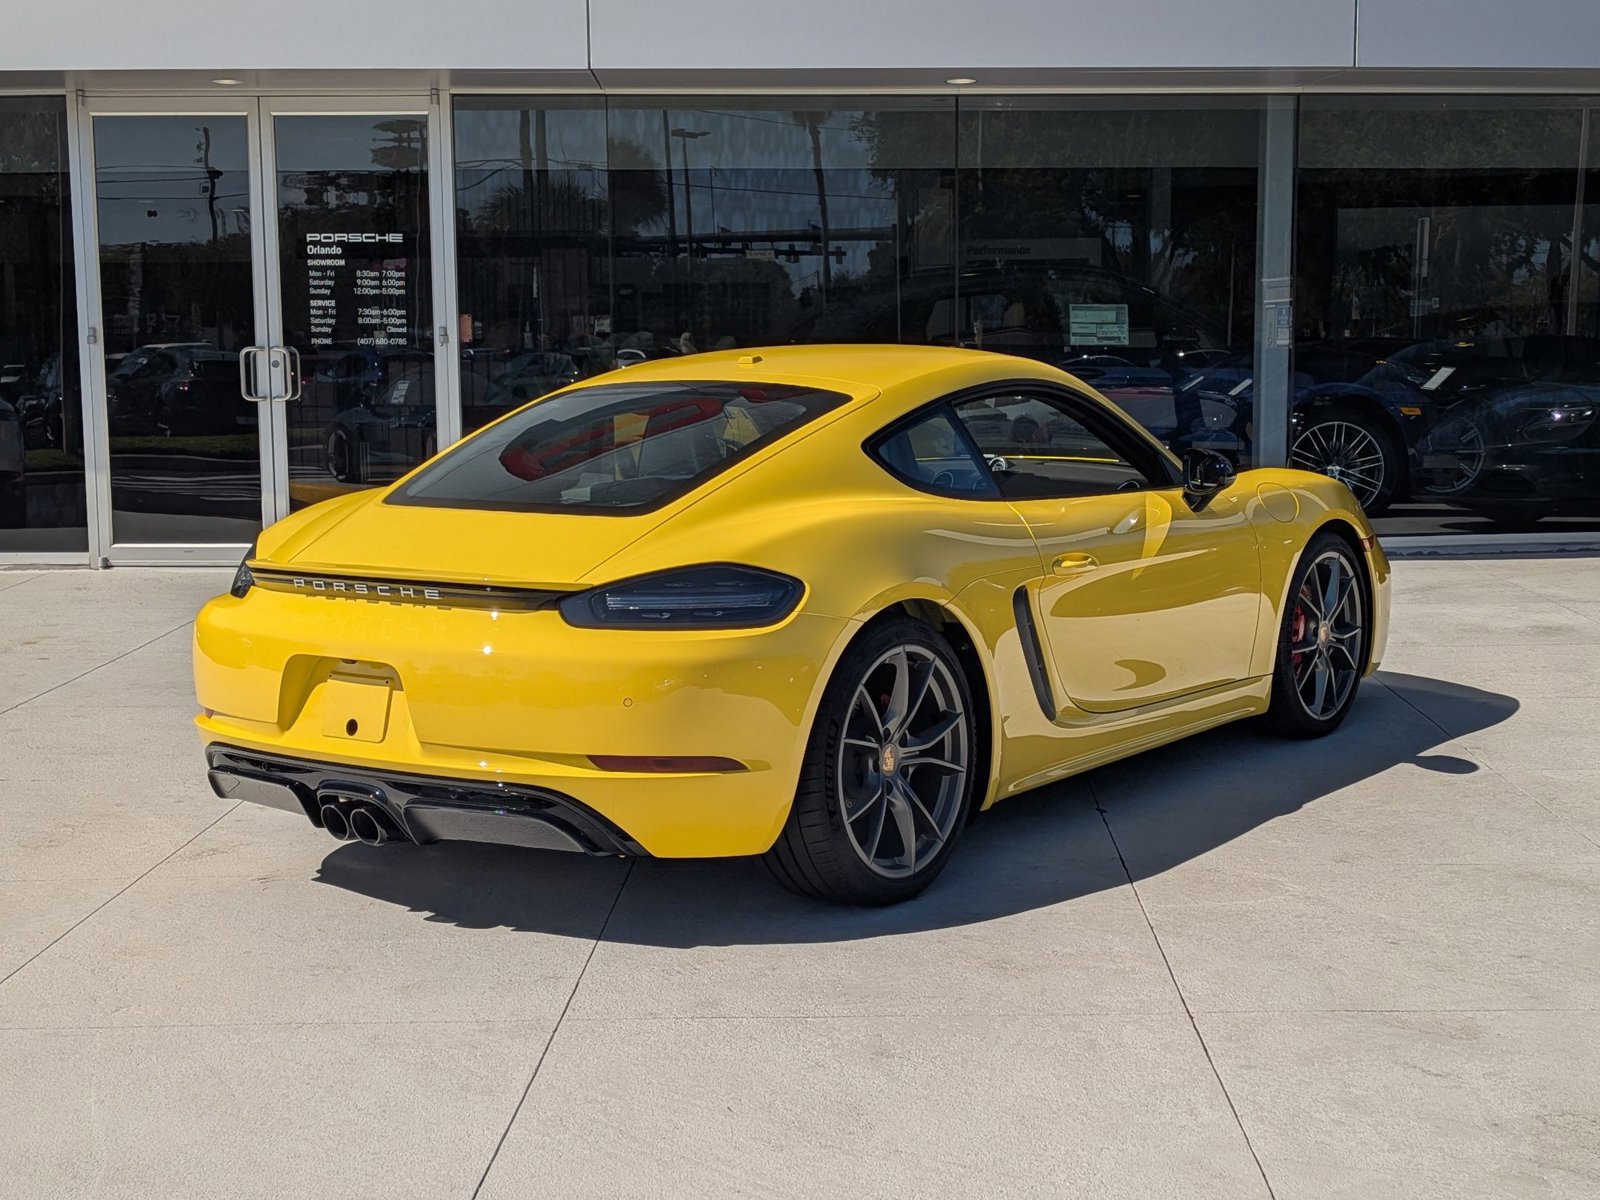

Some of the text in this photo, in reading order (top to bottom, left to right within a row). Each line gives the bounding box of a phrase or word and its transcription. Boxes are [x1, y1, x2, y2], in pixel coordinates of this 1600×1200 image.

[306, 233, 403, 242] PORSCHE
[307, 245, 342, 254] Orlando
[966, 244, 1031, 256] Performance
[382, 270, 405, 278] 7:00pm
[309, 279, 335, 287] Saturday
[309, 288, 331, 296] Sunday
[310, 317, 336, 325] Saturday
[311, 326, 332, 334] Sunday
[357, 338, 374, 346] (407)
[294, 578, 443, 600] PORSCHE
